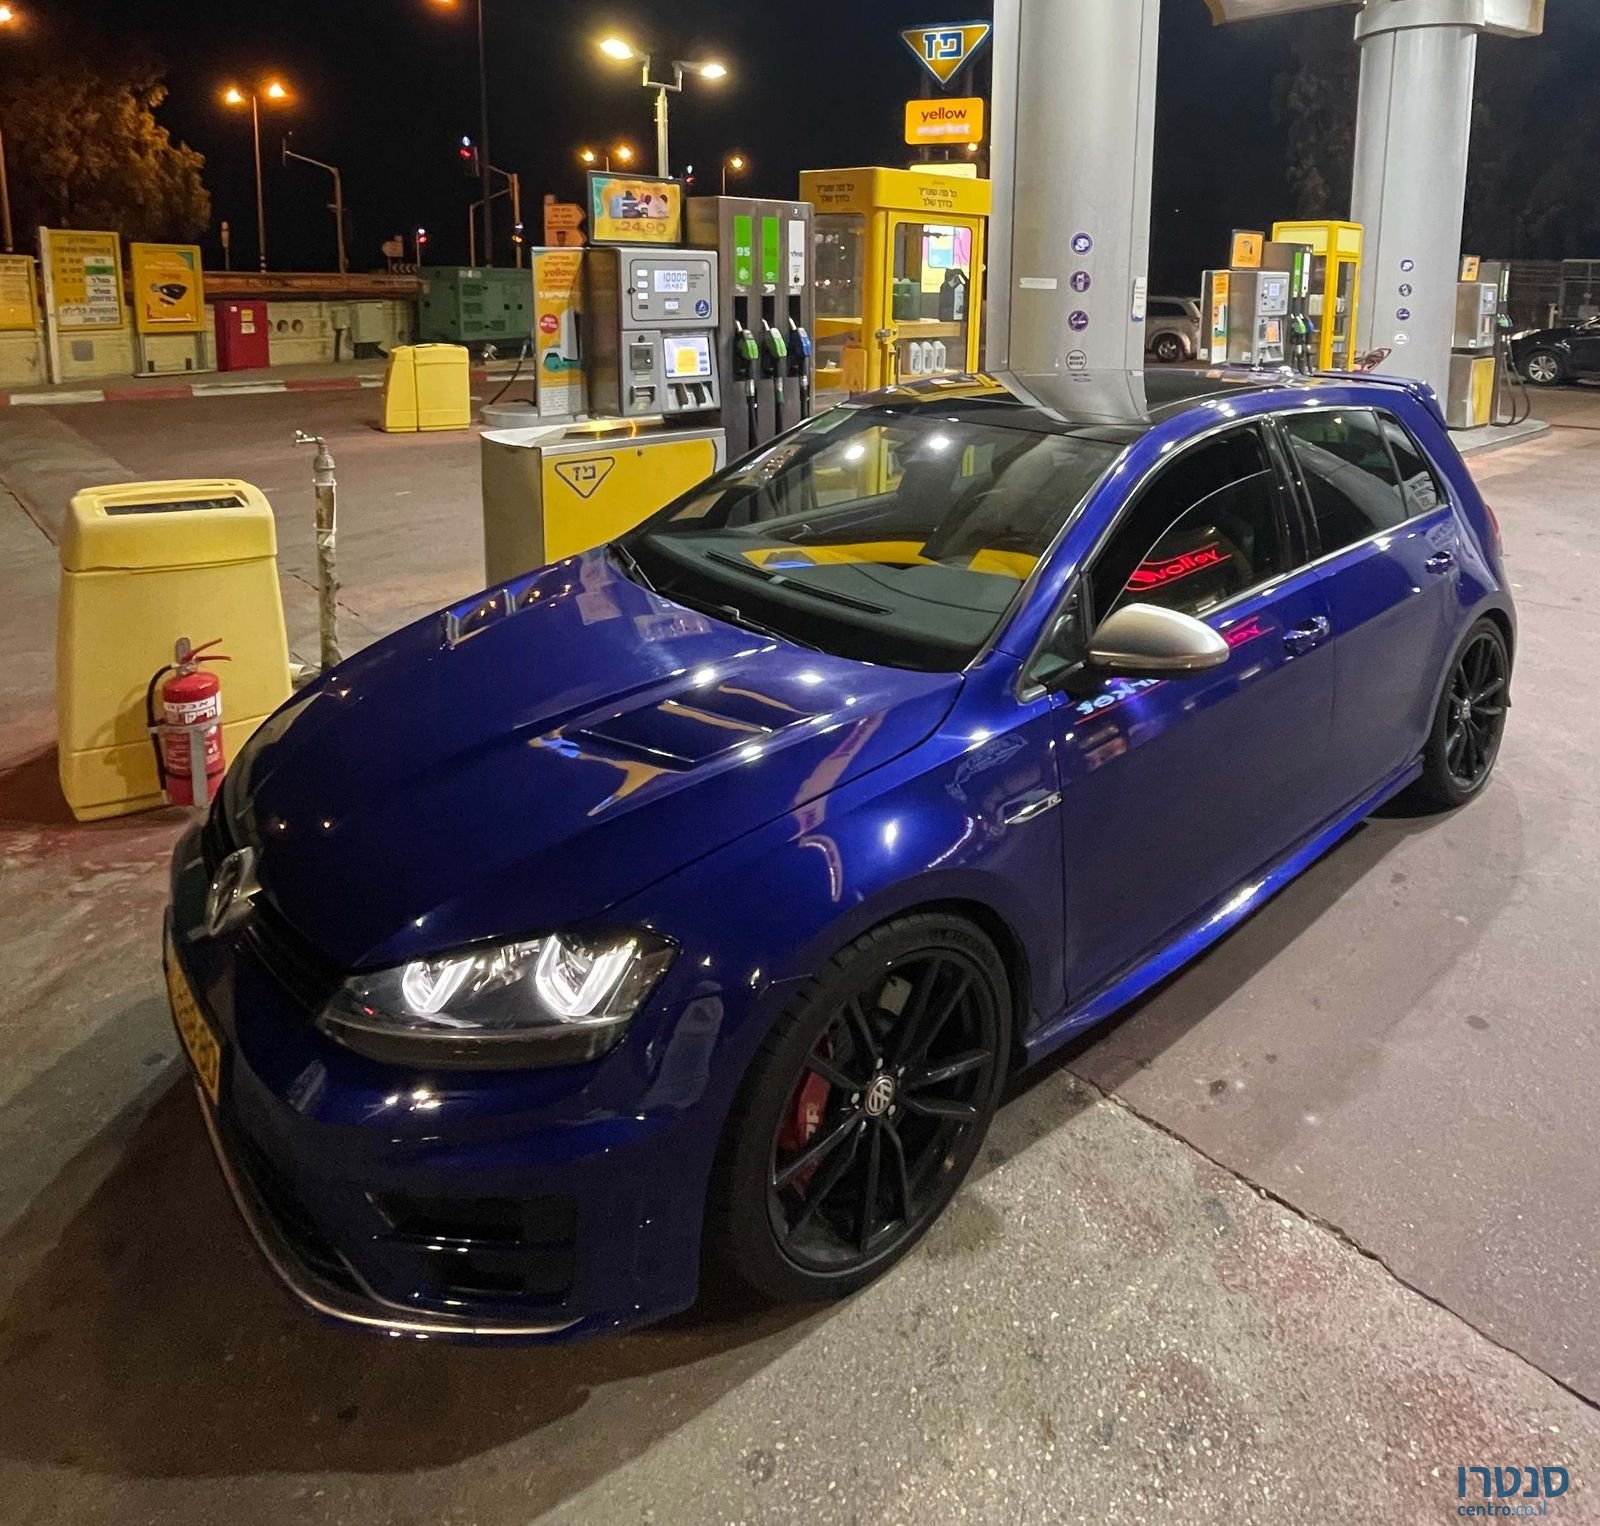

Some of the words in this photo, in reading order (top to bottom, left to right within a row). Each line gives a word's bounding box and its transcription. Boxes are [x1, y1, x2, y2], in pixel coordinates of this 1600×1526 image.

[923, 30, 964, 60] פז
[921, 107, 967, 122] yellow
[949, 189, 958, 198] כל
[922, 197, 937, 207] שלך
[736, 246, 751, 257] 95
[573, 465, 596, 481] פז
